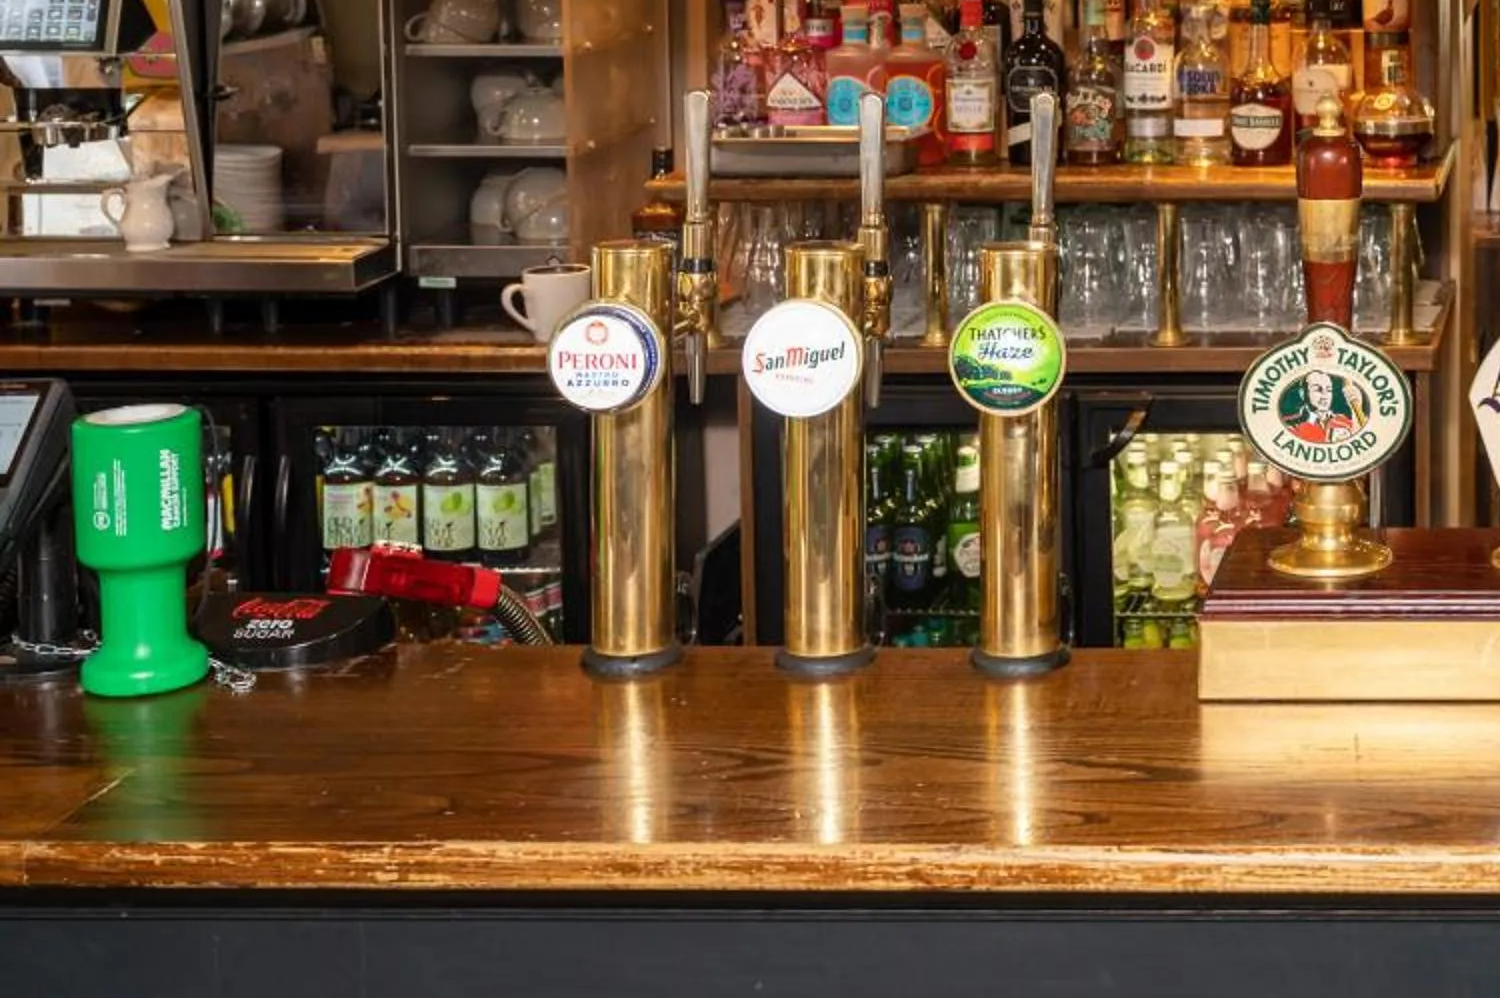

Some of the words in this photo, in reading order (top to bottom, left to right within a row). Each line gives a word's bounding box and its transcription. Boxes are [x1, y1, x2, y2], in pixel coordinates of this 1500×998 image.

[968, 325, 1047, 341] THATCHERS
[558, 351, 637, 370] PERONI
[1252, 347, 1309, 414] TIMOTHY
[1336, 347, 1399, 417] TAYLOR'S
[1272, 430, 1377, 463] LANDLORD
[247, 618, 295, 630] zero
[233, 628, 296, 640] SUGAR
